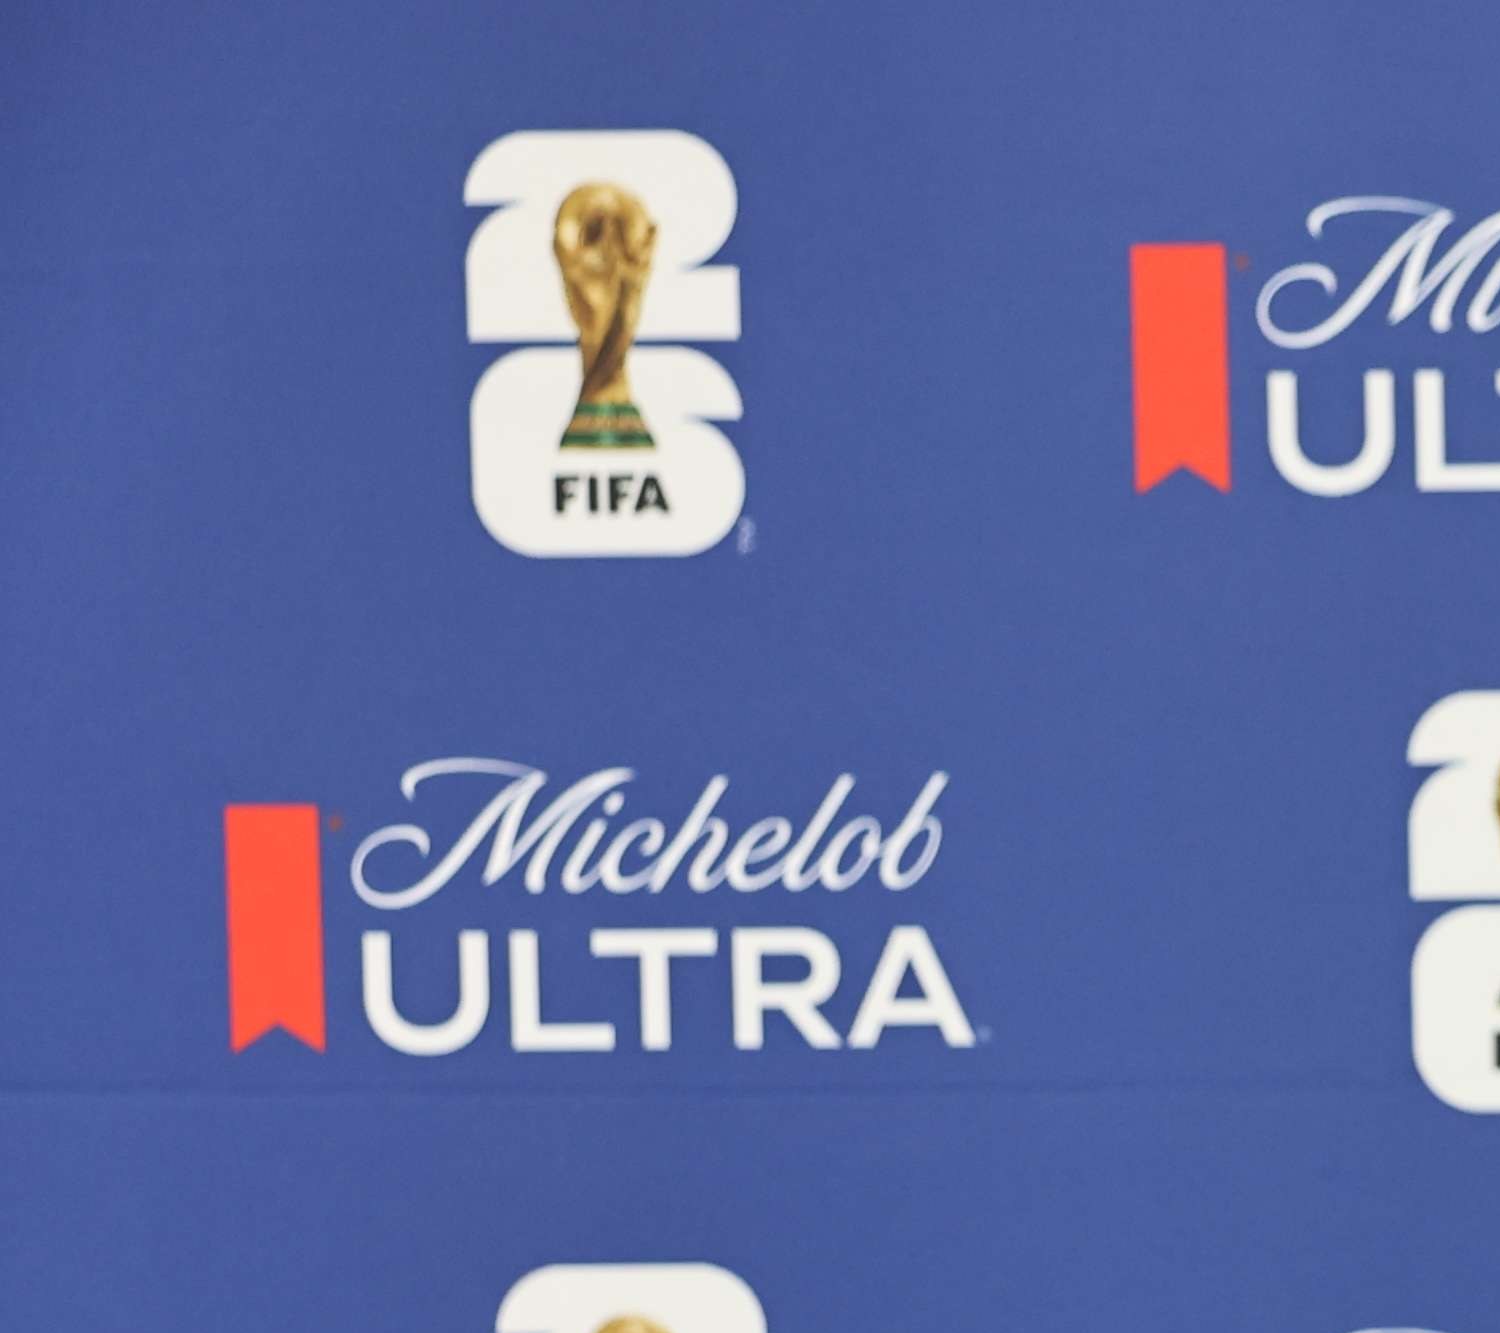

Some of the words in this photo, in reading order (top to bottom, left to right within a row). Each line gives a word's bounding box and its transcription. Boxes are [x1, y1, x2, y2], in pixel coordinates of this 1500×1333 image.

[554, 475, 670, 514] FIFA
[351, 758, 947, 909] Michelob
[362, 926, 975, 1055] ULTRA
